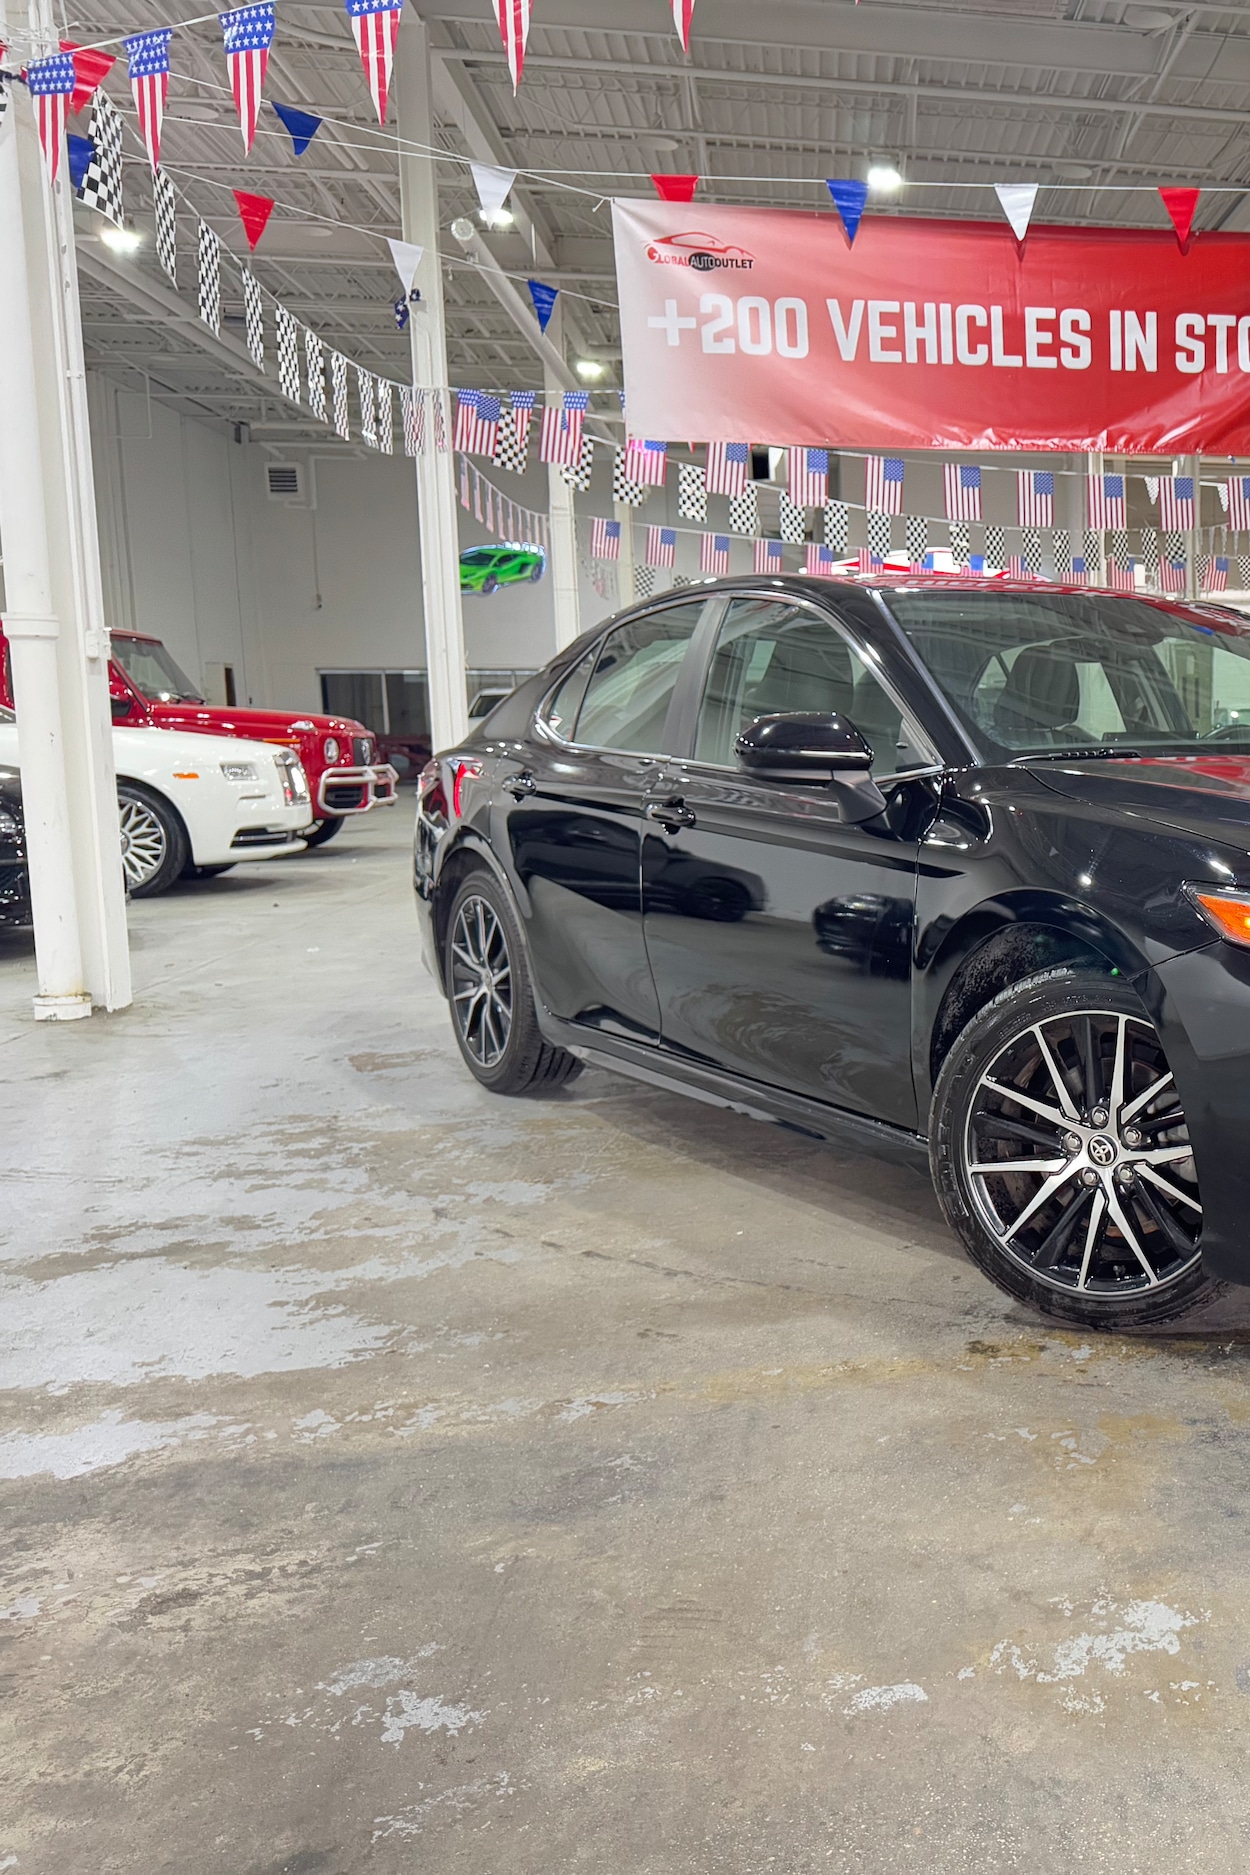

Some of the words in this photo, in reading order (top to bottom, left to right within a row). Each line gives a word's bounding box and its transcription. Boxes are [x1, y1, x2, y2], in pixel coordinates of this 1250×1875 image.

[647, 294, 809, 359] +200
[826, 299, 1092, 370] VEHICLES
[1109, 310, 1157, 372] IN
